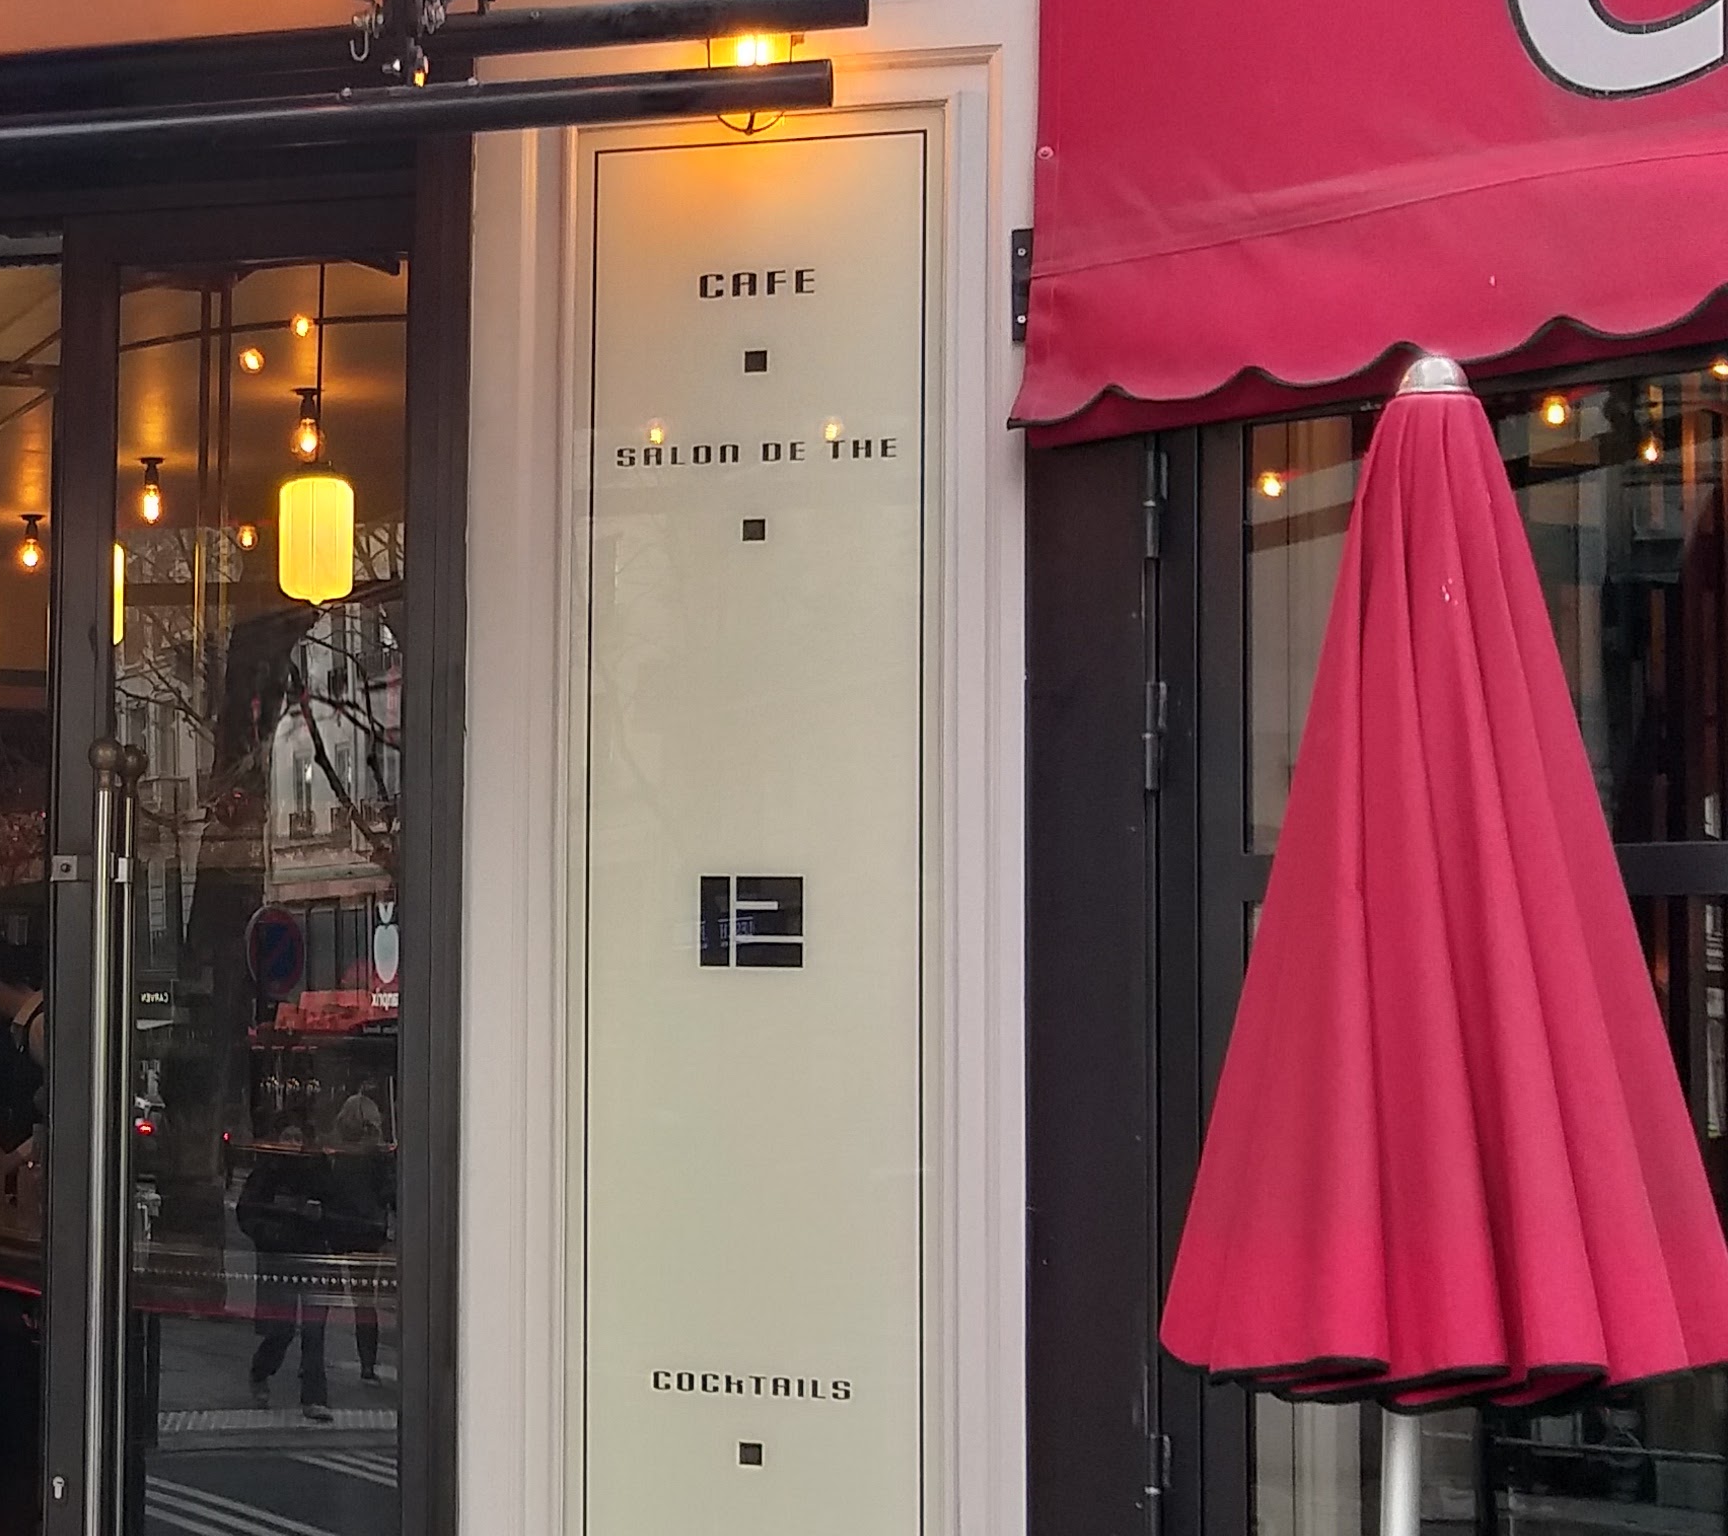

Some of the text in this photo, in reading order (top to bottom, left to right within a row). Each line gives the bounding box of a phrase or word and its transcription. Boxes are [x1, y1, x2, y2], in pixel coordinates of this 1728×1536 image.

[698, 268, 815, 299] CAFE
[617, 438, 897, 467] SALON DE THE
[652, 1370, 851, 1400] COCKTAILS
